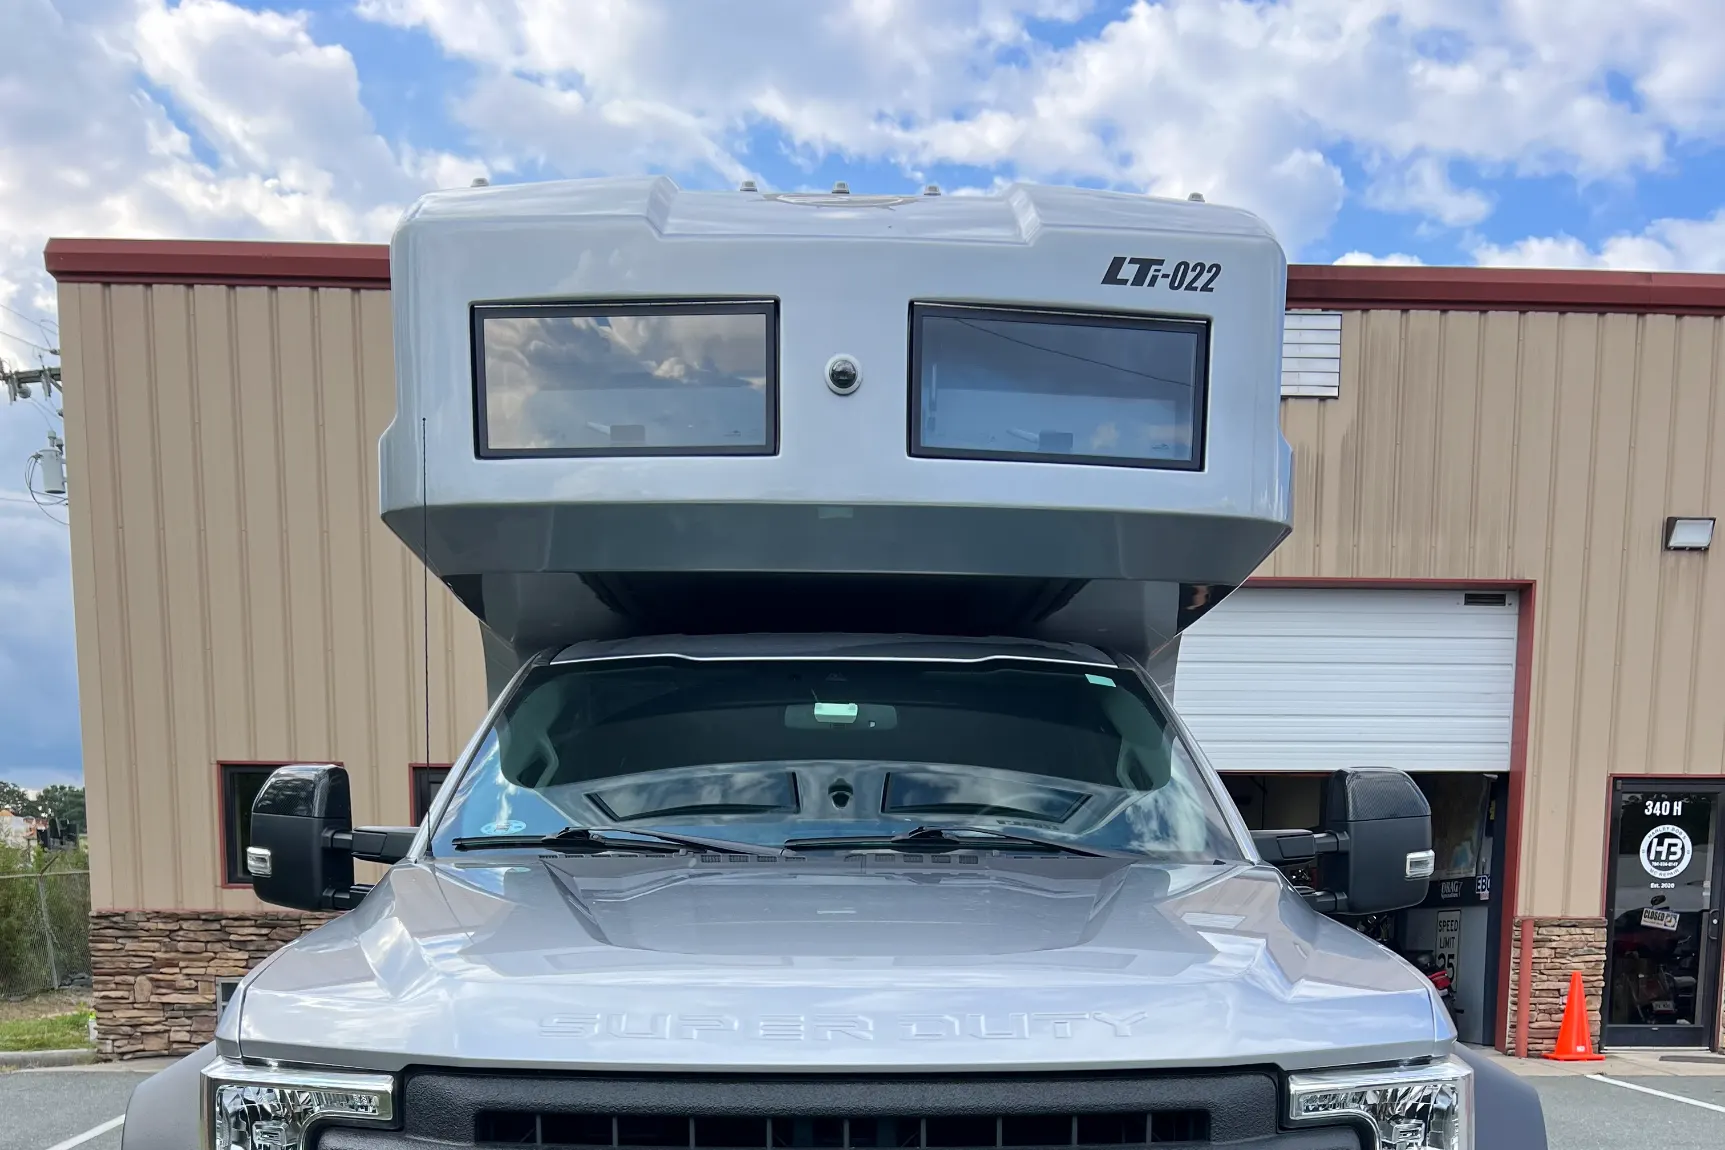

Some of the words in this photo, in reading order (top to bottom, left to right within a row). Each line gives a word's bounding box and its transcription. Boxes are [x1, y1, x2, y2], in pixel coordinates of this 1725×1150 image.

[1101, 256, 1222, 293] LTi-022
[1644, 800, 1670, 816] 340
[1673, 800, 1683, 816] H
[1648, 826, 1670, 840] HARLEY
[1649, 838, 1683, 861] HB
[1658, 868, 1680, 877] REPAIR
[1643, 908, 1665, 922] CLOSED
[1438, 920, 1459, 932] SPEED
[1439, 937, 1456, 949] LIMIT
[1438, 953, 1455, 982] 25
[538, 1011, 875, 1041] SUPER
[898, 1010, 1149, 1039] DUTY
